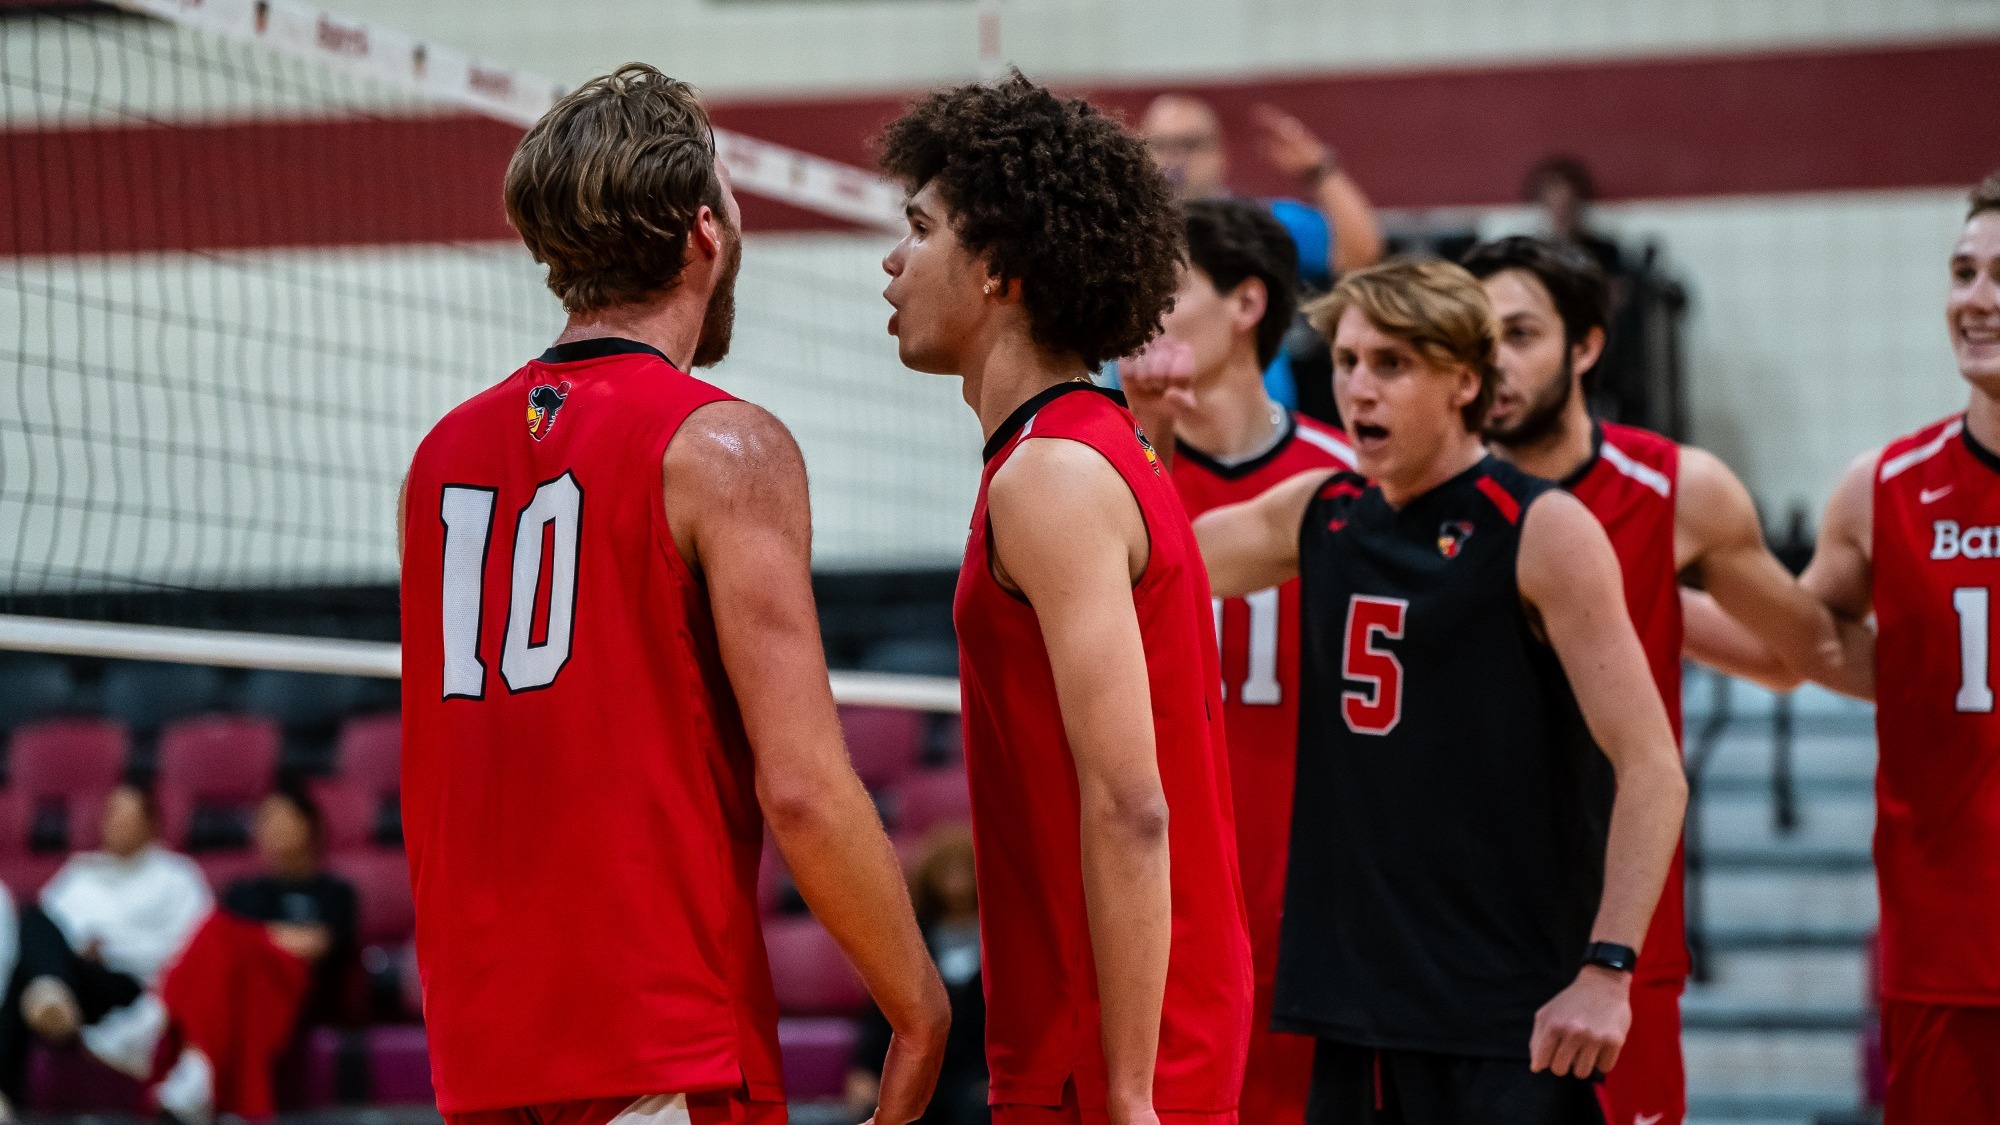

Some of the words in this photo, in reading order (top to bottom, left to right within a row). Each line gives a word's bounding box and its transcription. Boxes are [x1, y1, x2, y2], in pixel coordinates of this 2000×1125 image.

[440, 468, 584, 702] 10
[1930, 519, 2000, 560] Ba
[1211, 587, 1282, 706] 1
[1341, 594, 1410, 736] 5
